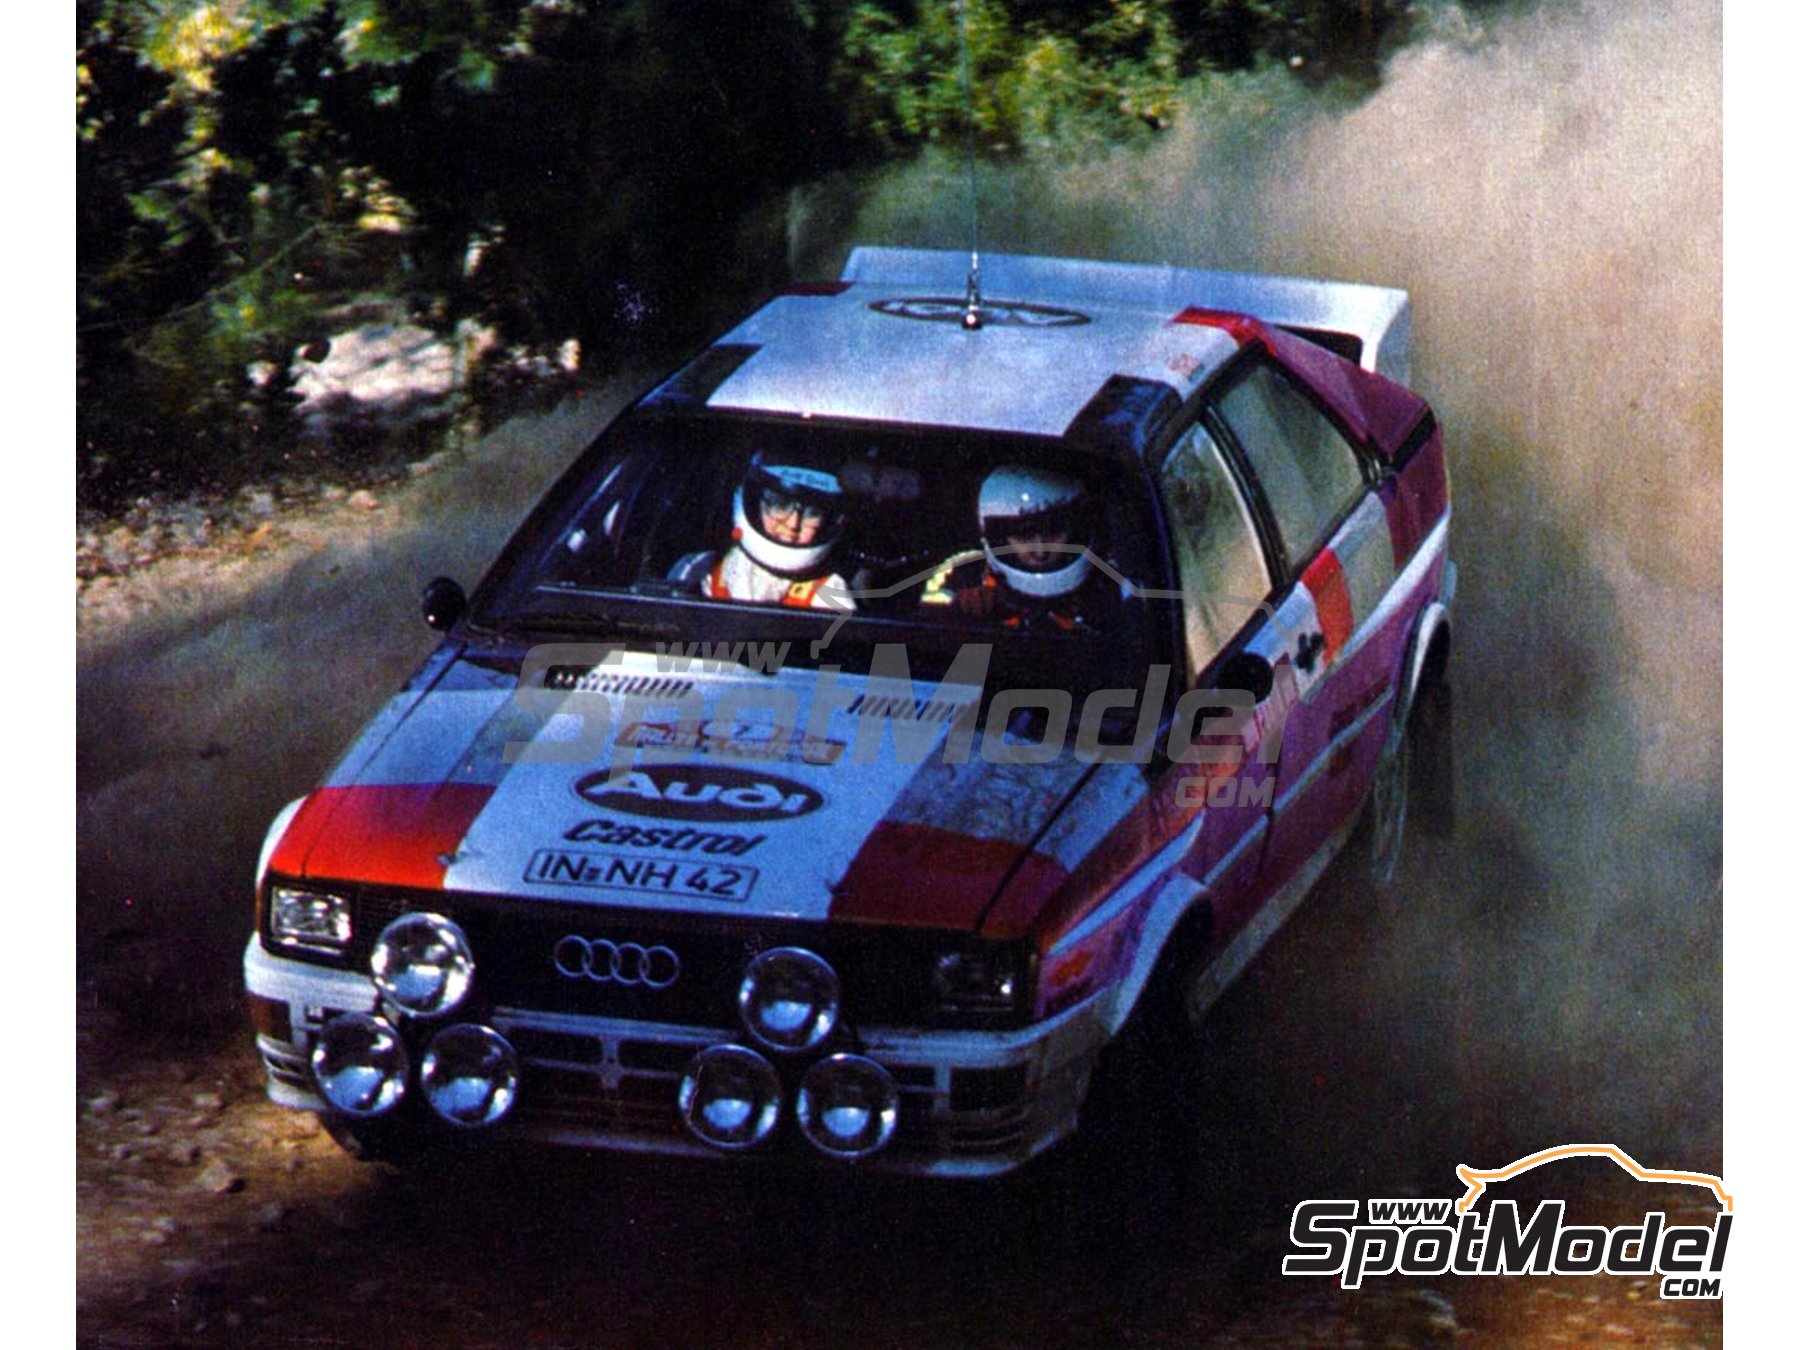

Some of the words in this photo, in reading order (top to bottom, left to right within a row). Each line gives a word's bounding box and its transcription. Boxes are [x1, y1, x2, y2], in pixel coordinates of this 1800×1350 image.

[585, 771, 809, 812] Audi
[563, 819, 767, 856] Castrol
[686, 867, 741, 895] 42
